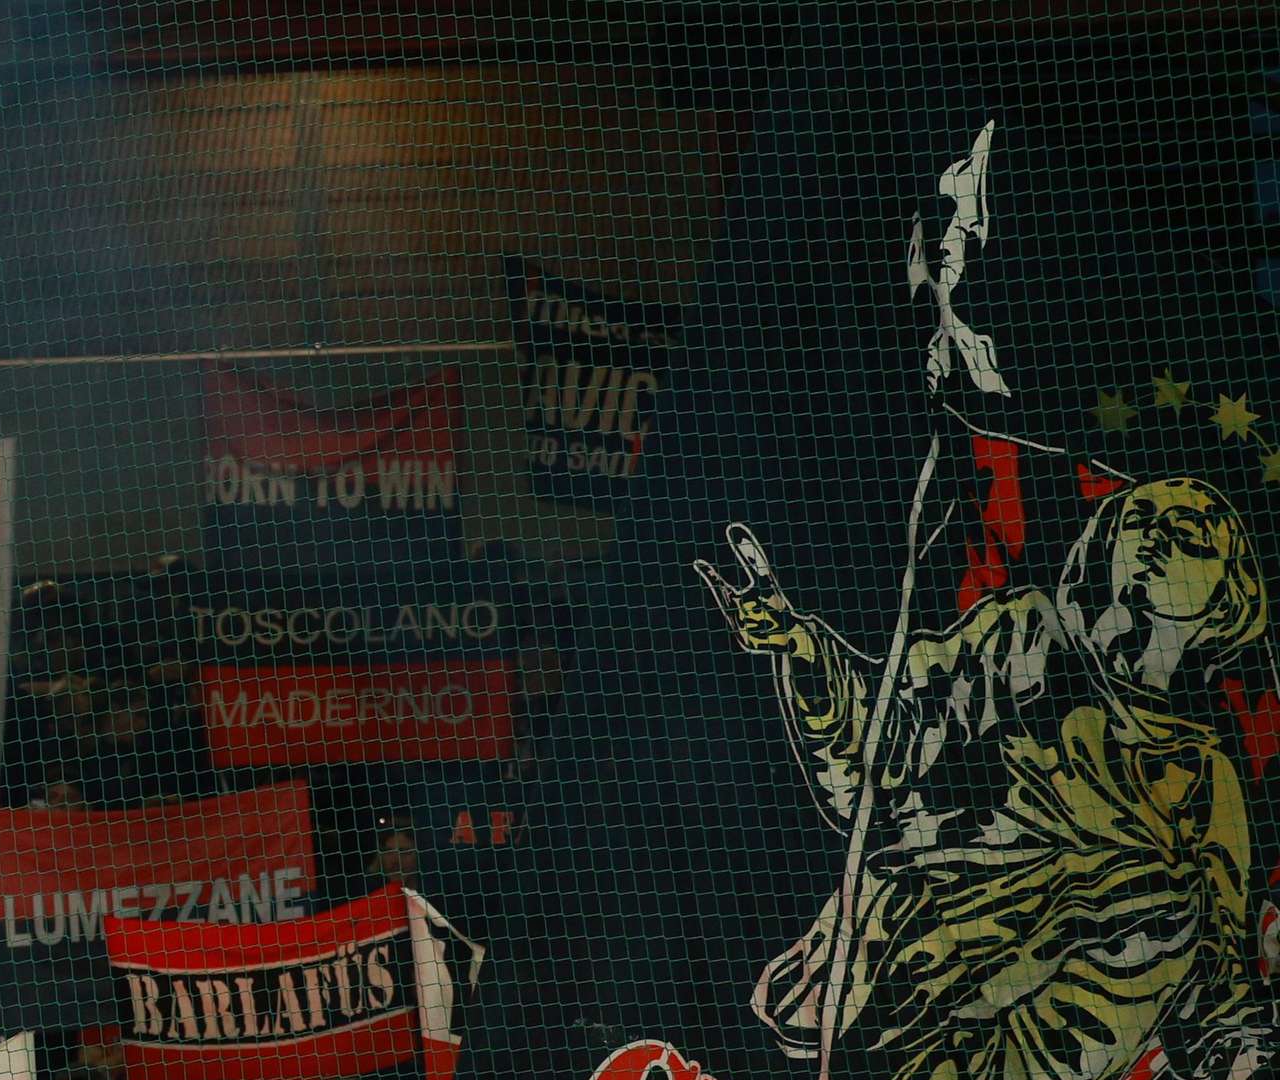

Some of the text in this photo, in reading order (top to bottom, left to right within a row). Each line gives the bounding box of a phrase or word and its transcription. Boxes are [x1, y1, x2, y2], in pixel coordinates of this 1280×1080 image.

[314, 462, 366, 510] TO
[378, 458, 455, 511] WIN
[188, 602, 499, 647] TOSCOLANO
[209, 683, 474, 729] MADERNO
[3, 866, 306, 949] LUMEZZANE
